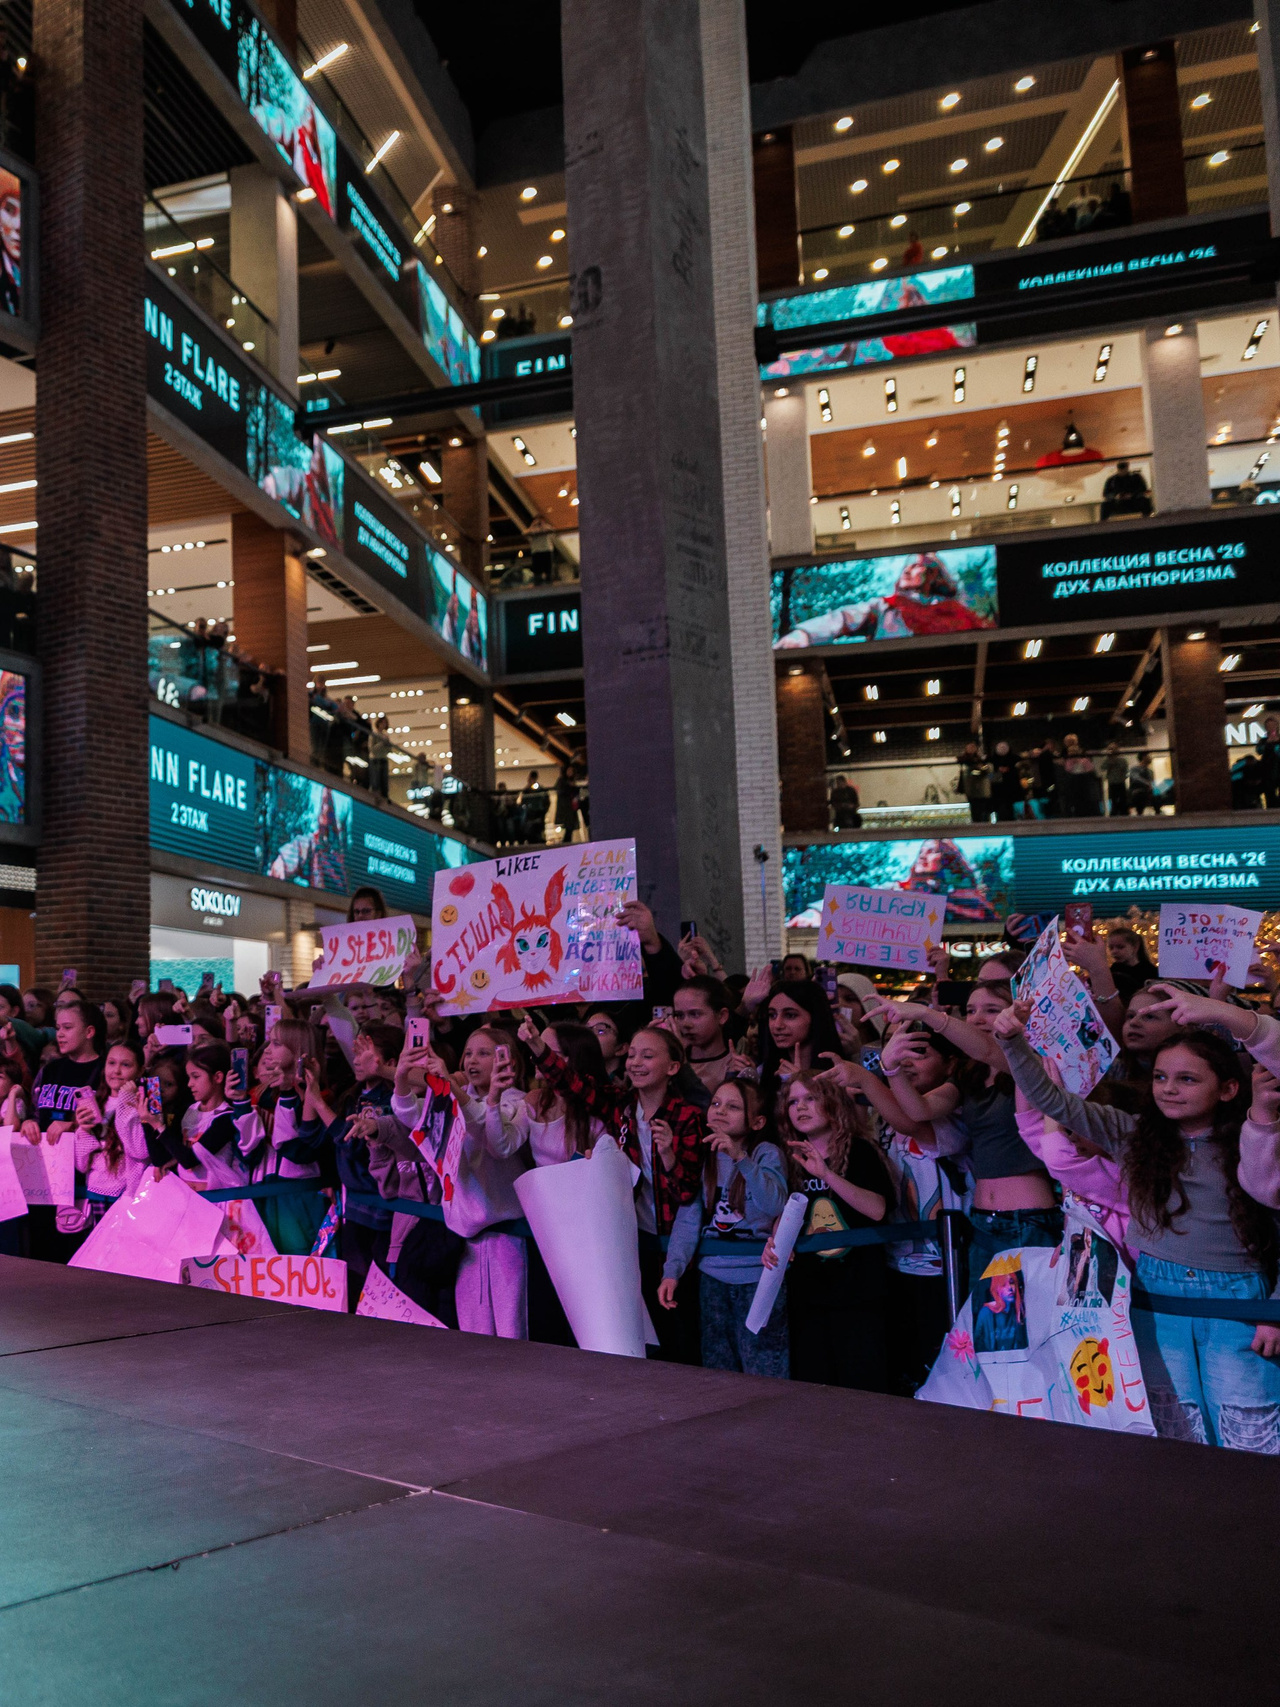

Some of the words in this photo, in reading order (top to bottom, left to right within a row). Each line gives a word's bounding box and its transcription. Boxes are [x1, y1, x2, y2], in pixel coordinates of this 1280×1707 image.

[164, 361, 173, 386] 2
[181, 331, 240, 412] FLARE
[1042, 552, 1150, 578] КОЛЛЕКЦИЯ
[1154, 546, 1215, 567] ВЕСНА
[1217, 542, 1246, 559] '26
[1053, 578, 1090, 599] ДУХ
[1092, 563, 1236, 592] АВАНТЮРИЗМА
[188, 758, 248, 812] FLARE
[170, 801, 179, 824] 2
[179, 805, 209, 834] ЭТАЖ
[1061, 855, 1172, 873] КОЛЛЕКЦИЯ
[1176, 852, 1238, 870] ВЕСНА
[1072, 877, 1110, 896] ДУХ
[1113, 872, 1260, 892] АВАНТЮРИЗМА
[191, 886, 241, 918] SOKOLOV
[845, 891, 926, 918] КРУТАЯ
[842, 916, 920, 942] ЛУЧШАЯ
[834, 940, 919, 964] STESHOK
